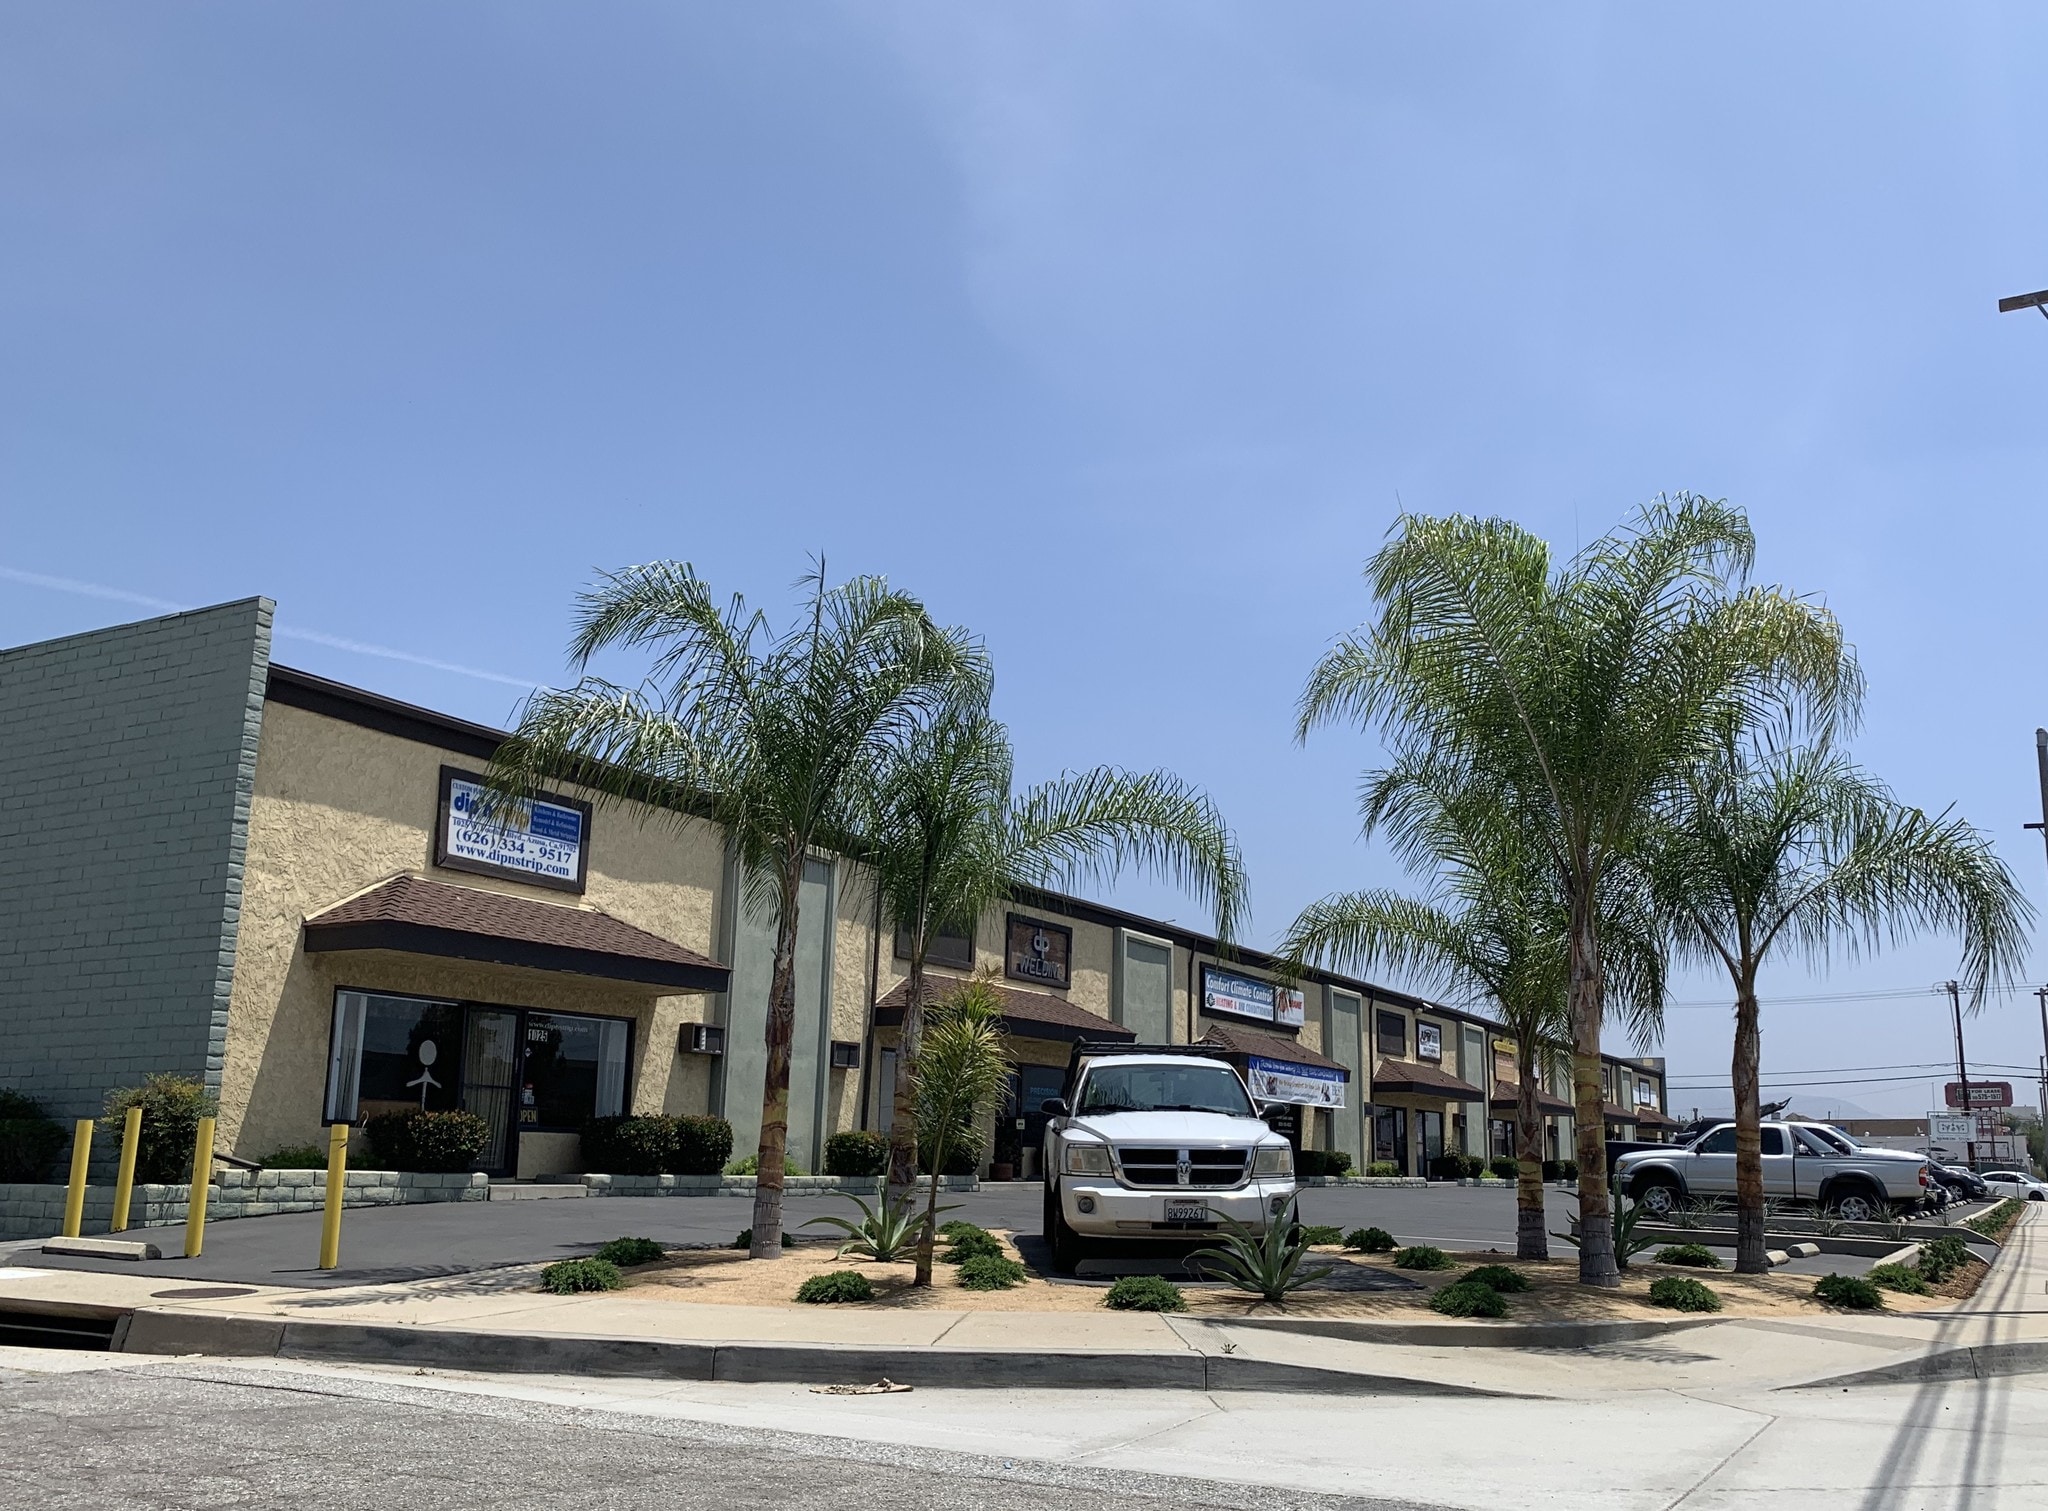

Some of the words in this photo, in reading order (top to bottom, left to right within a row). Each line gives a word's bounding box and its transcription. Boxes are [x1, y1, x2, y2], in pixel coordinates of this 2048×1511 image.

[456, 844, 570, 877] www.dipnstrip.com
[499, 838, 525, 854] 334
[539, 846, 572, 864] 9517
[1206, 974, 1230, 992] Comfort
[1230, 980, 1252, 997] Climate
[528, 1029, 548, 1042] 1025
